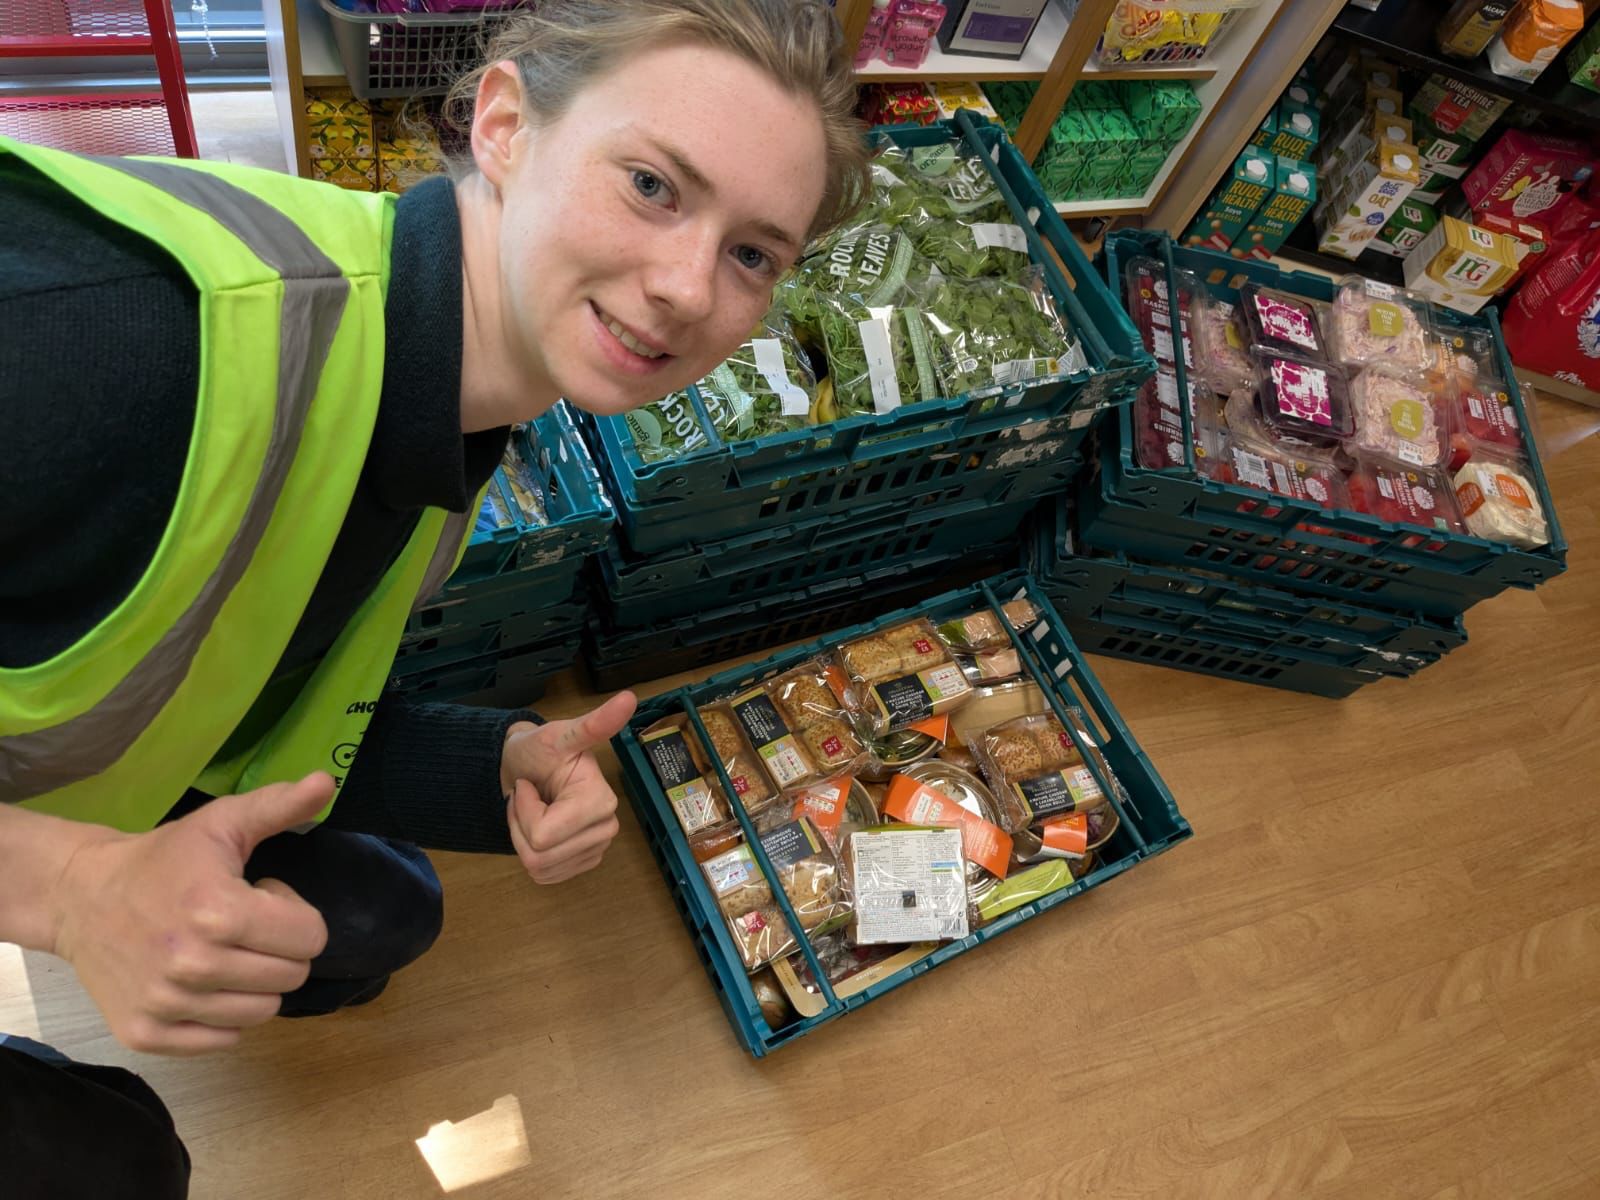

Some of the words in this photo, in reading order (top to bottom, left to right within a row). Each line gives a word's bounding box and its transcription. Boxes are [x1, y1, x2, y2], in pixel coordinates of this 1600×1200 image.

[1445, 77, 1495, 109] YORKSHIRE
[1452, 95, 1472, 110] TEA
[1272, 132, 1312, 156] RUDE
[1430, 141, 1456, 161] PG
[919, 143, 951, 170] organic
[1222, 192, 1259, 209] HEALTH
[1229, 179, 1269, 202] RUDE
[1368, 193, 1393, 209] OAT
[1264, 206, 1300, 223] HEALTH
[1271, 193, 1311, 216] RUDE
[1395, 230, 1421, 248] PG
[1471, 228, 1492, 246] PG
[857, 233, 891, 286] LEAVES
[1454, 257, 1491, 282] PG
[1485, 399, 1498, 427] CHUNKS
[1490, 392, 1507, 437] WATERMELON
[626, 412, 652, 443] ganic
[1395, 477, 1408, 506] CHUNKS
[1400, 471, 1417, 518] WATERMELON
[346, 700, 379, 715] CHO
[748, 705, 761, 721] MATURE
[757, 721, 771, 741] CHEDDAR
[661, 743, 672, 761] MATURE
[1033, 793, 1049, 802] MATURE
[1049, 789, 1067, 798] CHEDDAR
[764, 832, 792, 849] CARAMELISE
[780, 834, 799, 845] MATURE
